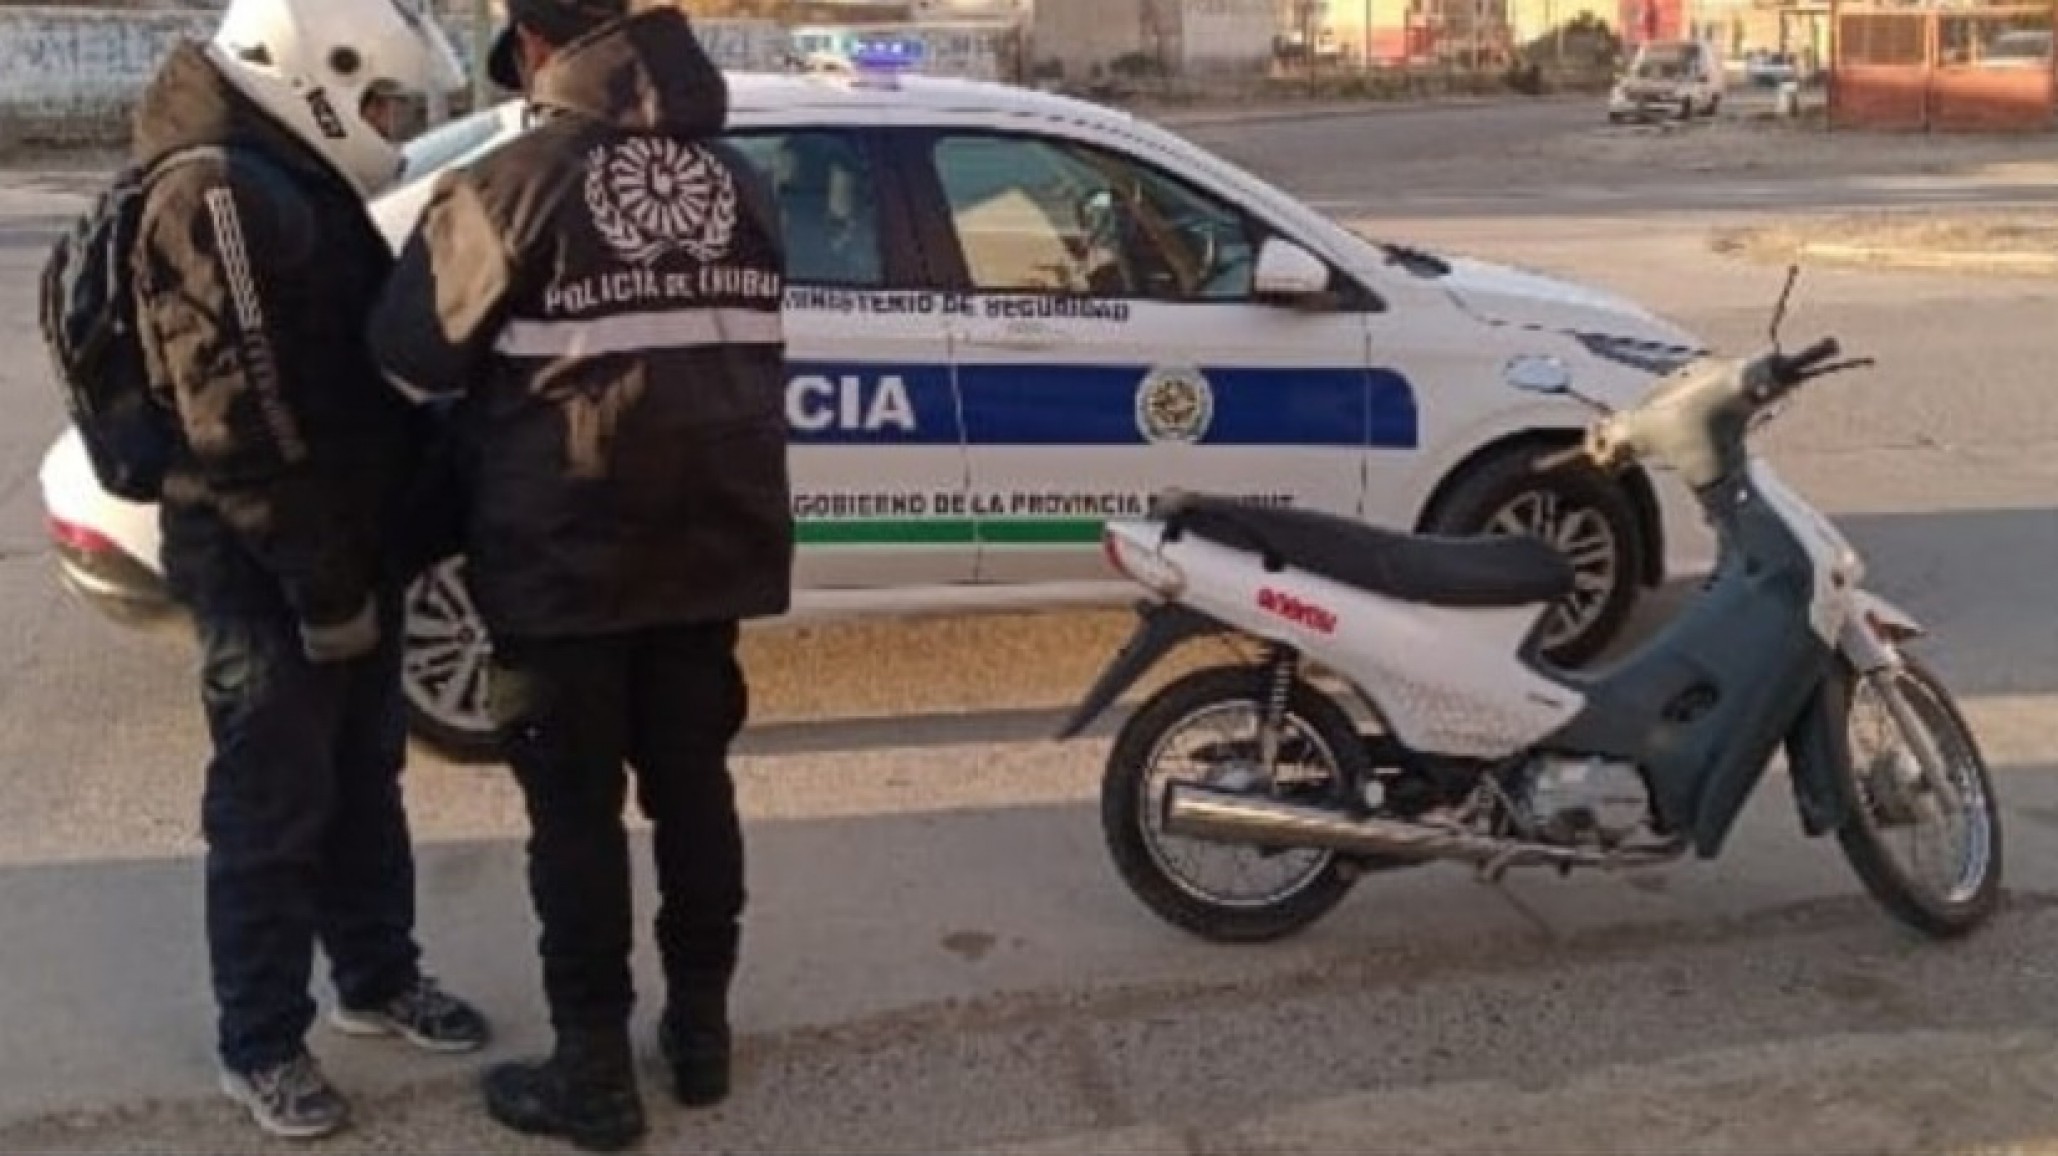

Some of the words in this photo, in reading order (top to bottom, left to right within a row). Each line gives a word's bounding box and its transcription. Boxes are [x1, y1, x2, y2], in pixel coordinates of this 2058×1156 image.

[943, 293, 974, 316] DE
[793, 493, 926, 514] GOBIERNO
[935, 493, 966, 514] DE
[971, 493, 1005, 514] LA
[1011, 493, 1142, 514] PROVINCIA
